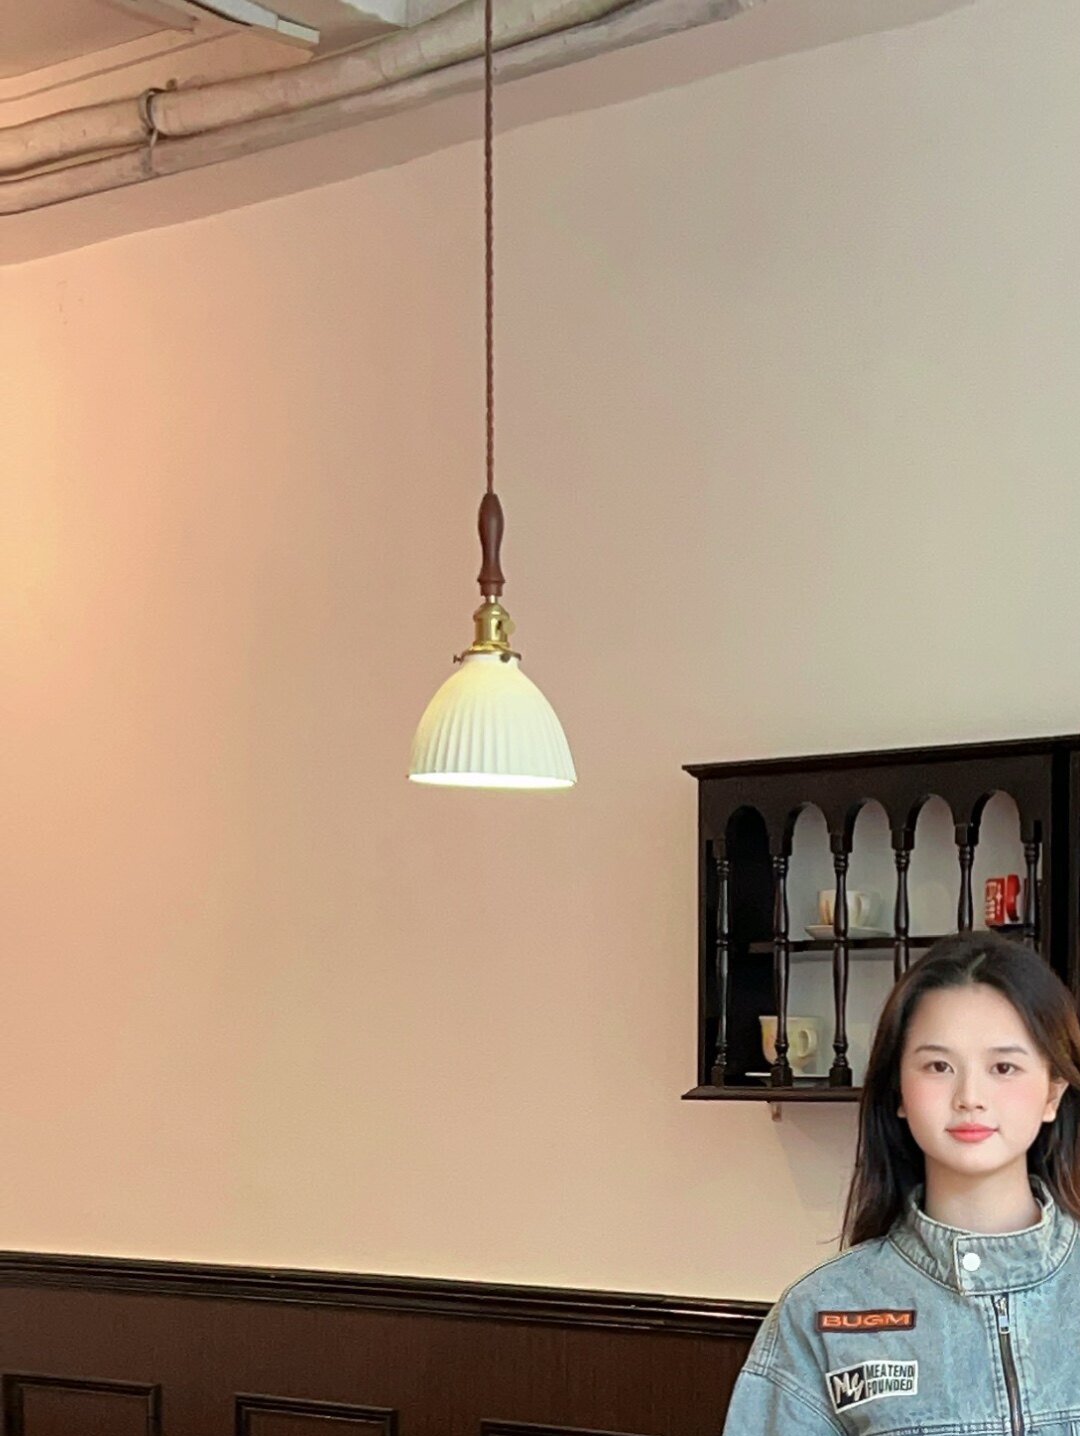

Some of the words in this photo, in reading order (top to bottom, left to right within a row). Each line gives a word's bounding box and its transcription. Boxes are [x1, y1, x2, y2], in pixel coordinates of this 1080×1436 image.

[821, 1312, 911, 1328] BUGM
[866, 1363, 914, 1379] MEATEND
[867, 1378, 913, 1396] FOUNDED
